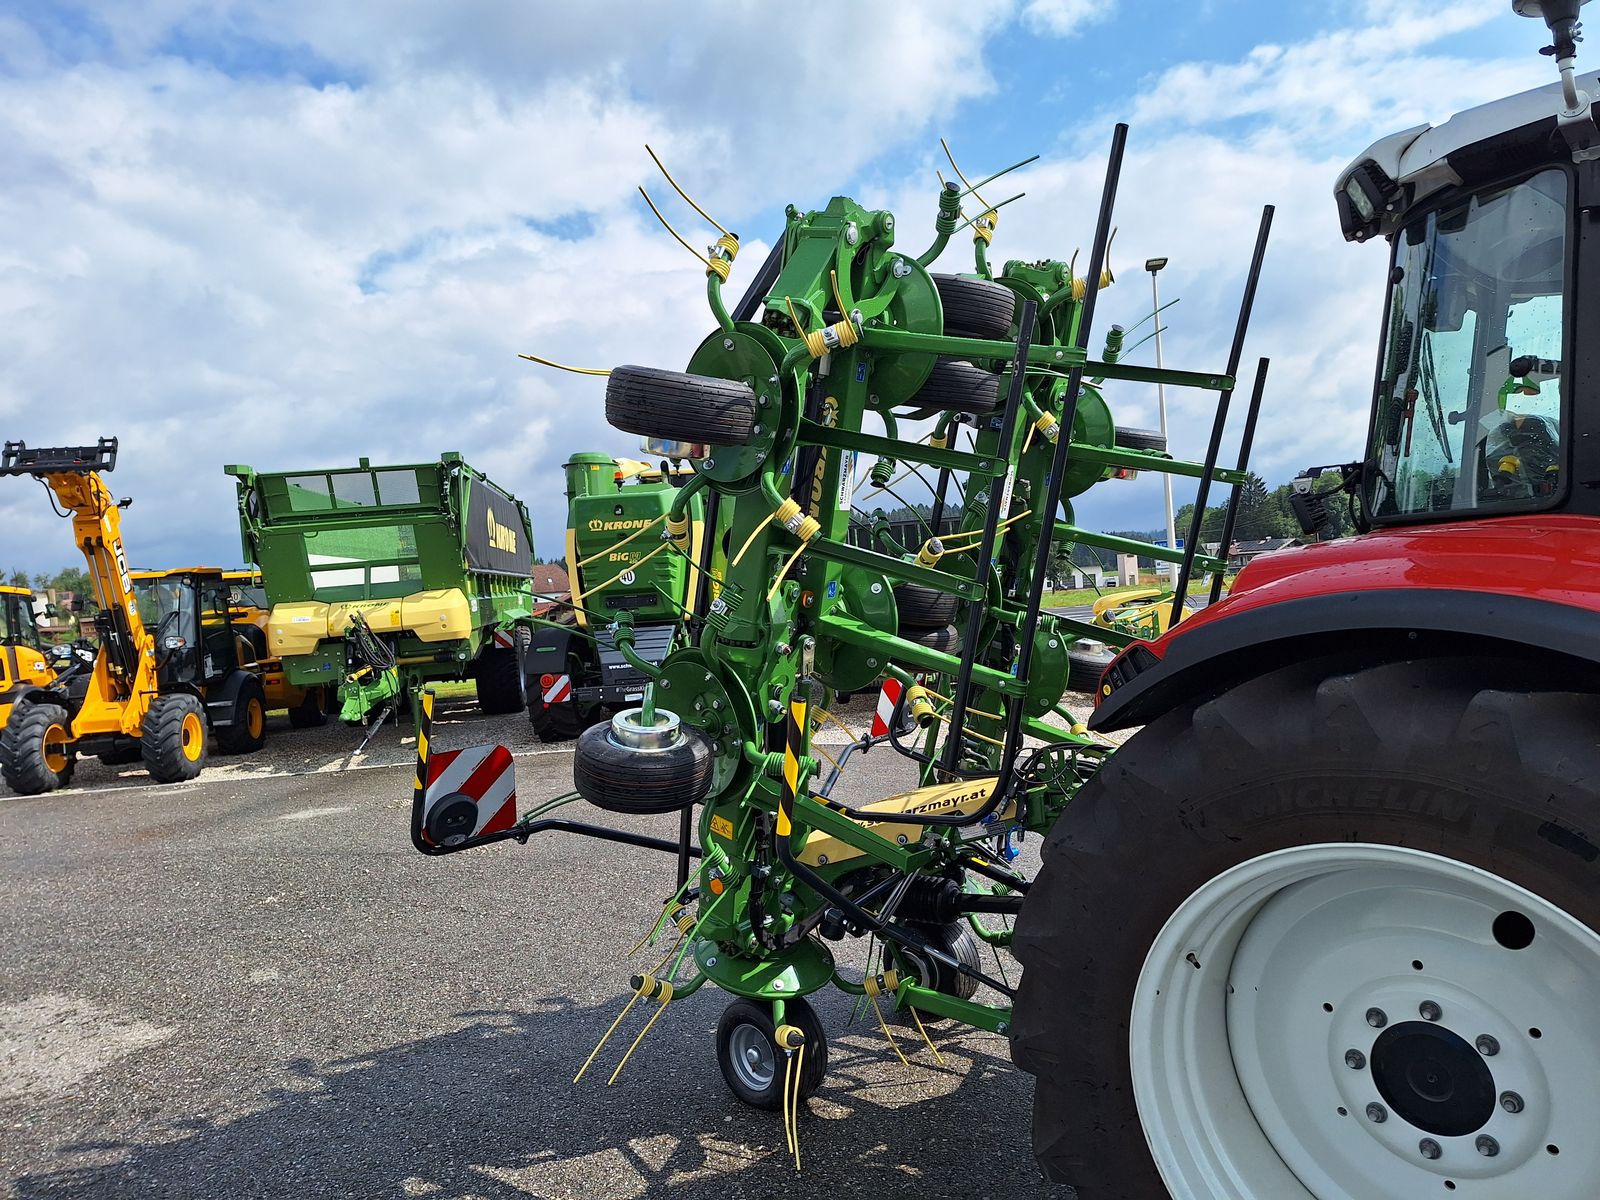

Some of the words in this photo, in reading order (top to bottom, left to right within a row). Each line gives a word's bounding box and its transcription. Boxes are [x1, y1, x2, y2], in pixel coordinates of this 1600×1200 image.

[839, 455, 850, 505] SCHWARZMAYR
[495, 522, 517, 554] KRONE
[604, 519, 652, 531] KRONE
[112, 538, 132, 594] JCB
